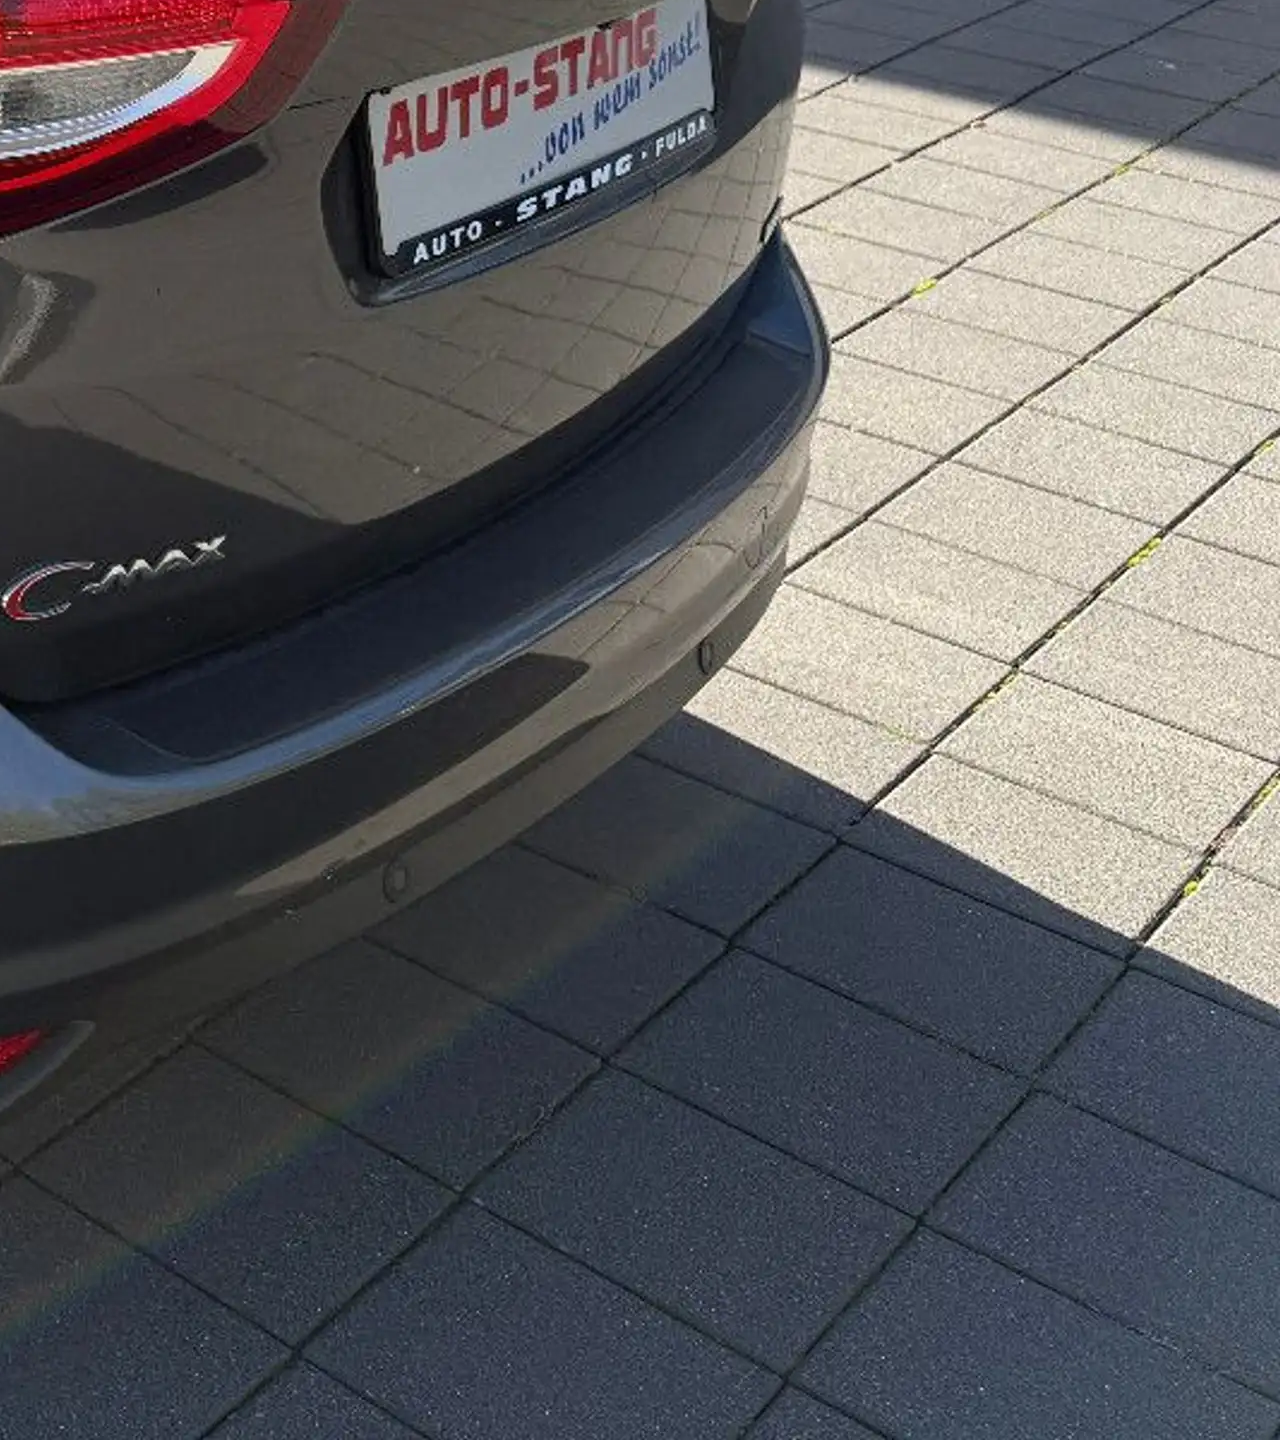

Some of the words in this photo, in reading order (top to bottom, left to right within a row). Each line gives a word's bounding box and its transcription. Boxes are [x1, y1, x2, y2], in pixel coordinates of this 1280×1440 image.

[382, 8, 658, 167] AUTO-STANG
[594, 72, 641, 131] wem
[412, 221, 483, 265] AUTO
[516, 153, 634, 224] STANG
[655, 115, 708, 159] FULDA
